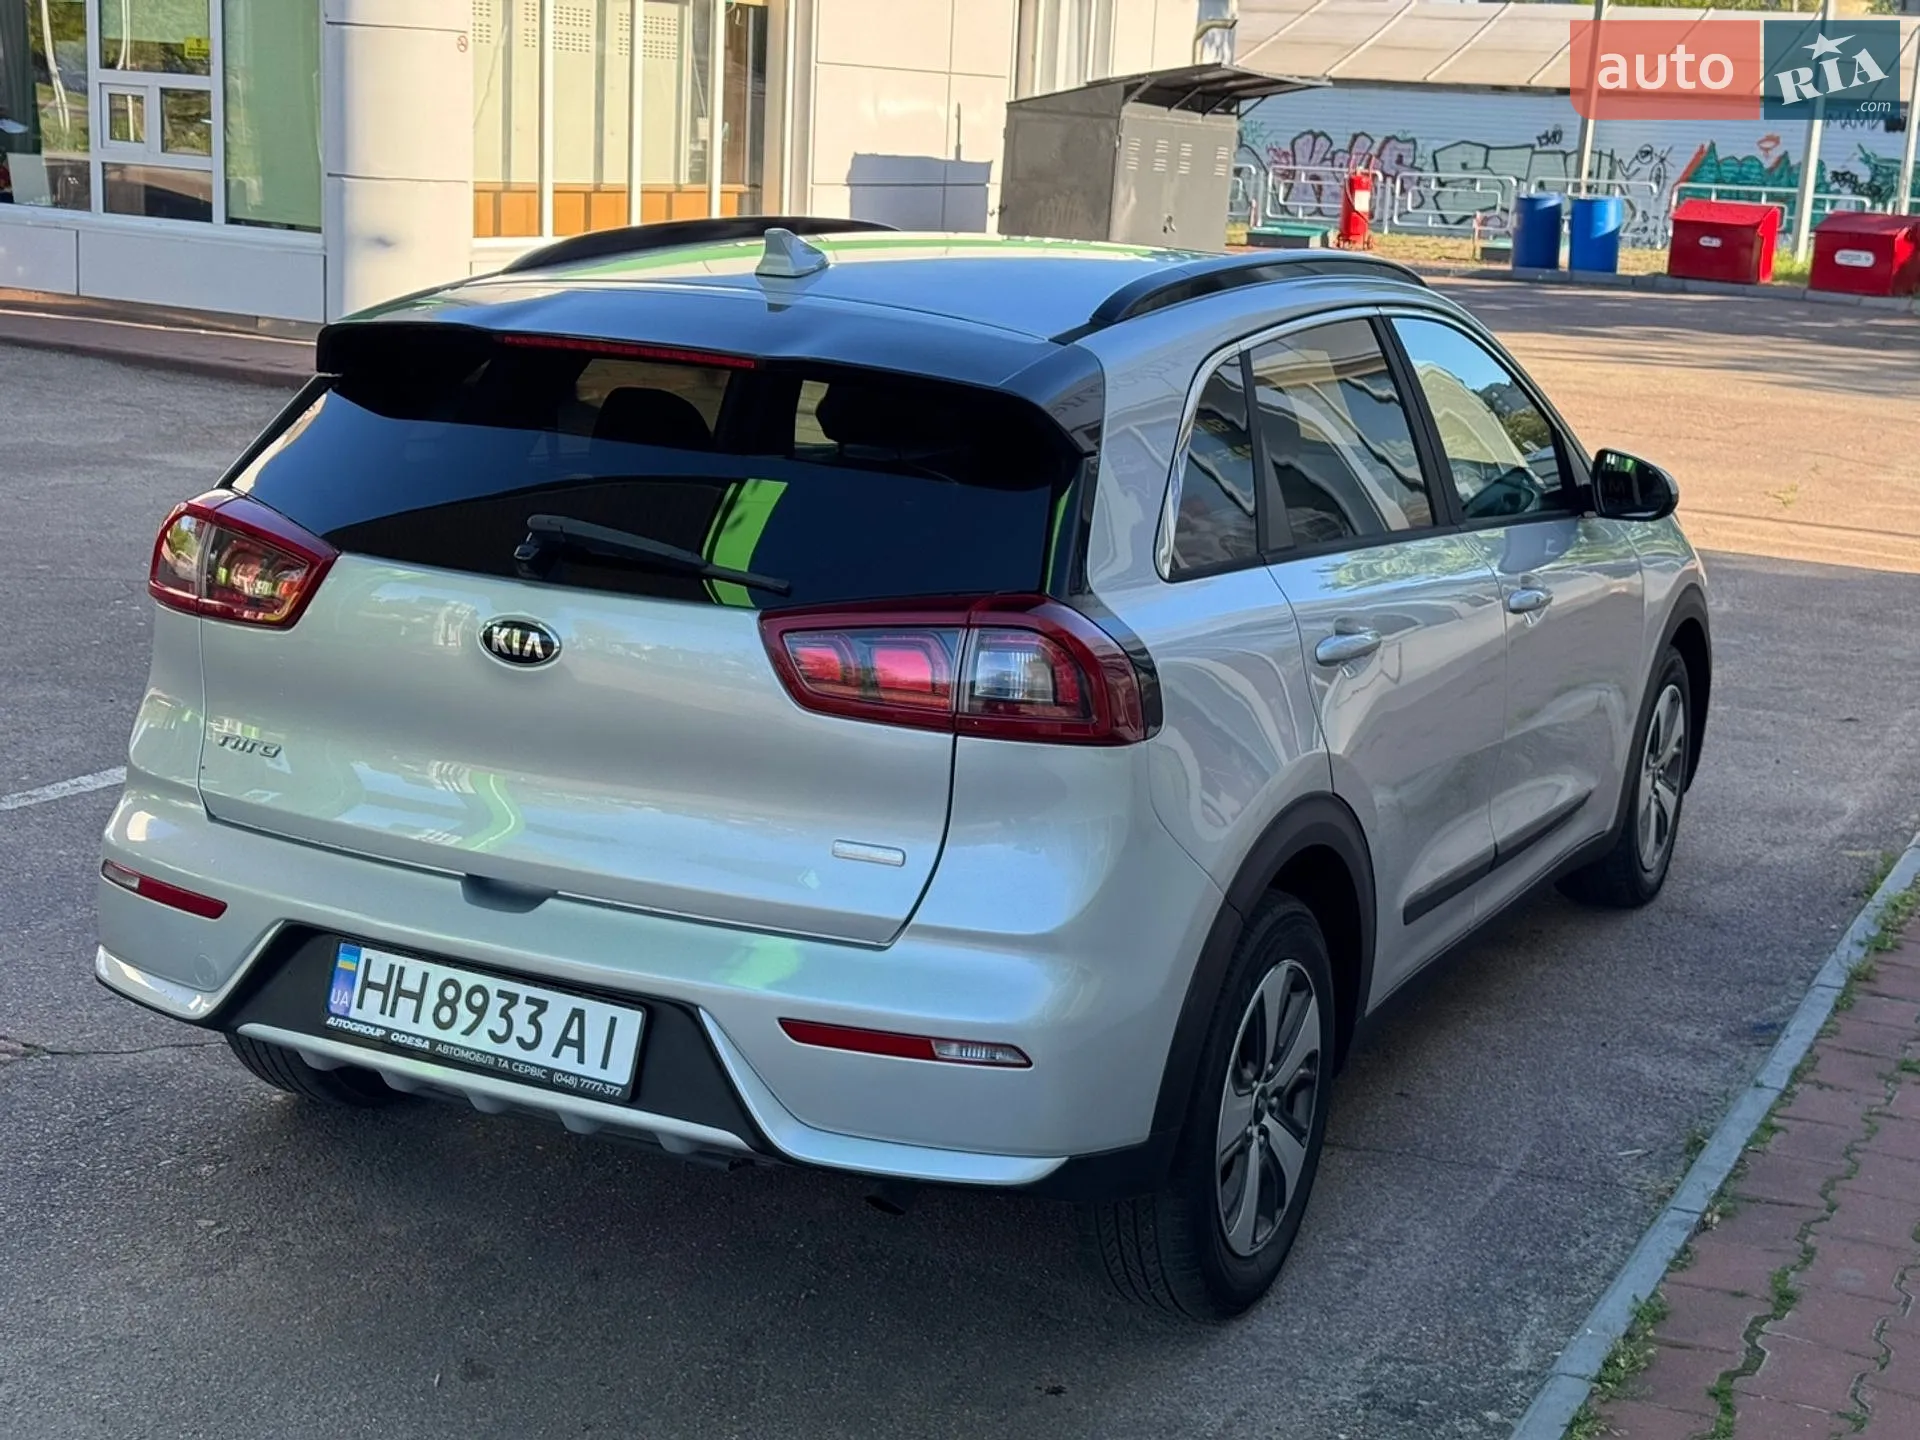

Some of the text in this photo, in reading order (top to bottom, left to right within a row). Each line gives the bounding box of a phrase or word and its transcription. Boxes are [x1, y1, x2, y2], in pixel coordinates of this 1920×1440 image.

[492, 626, 545, 659] KIA
[329, 988, 349, 1007] UA
[326, 1017, 386, 1037] AUTOGROUP
[390, 1032, 430, 1049] ODESA
[435, 1043, 495, 1065] АВТОМОБІЛІ
[497, 1058, 509, 1069] ТА
[512, 1063, 548, 1079] СЕРВІС
[553, 1072, 578, 1088] (048)
